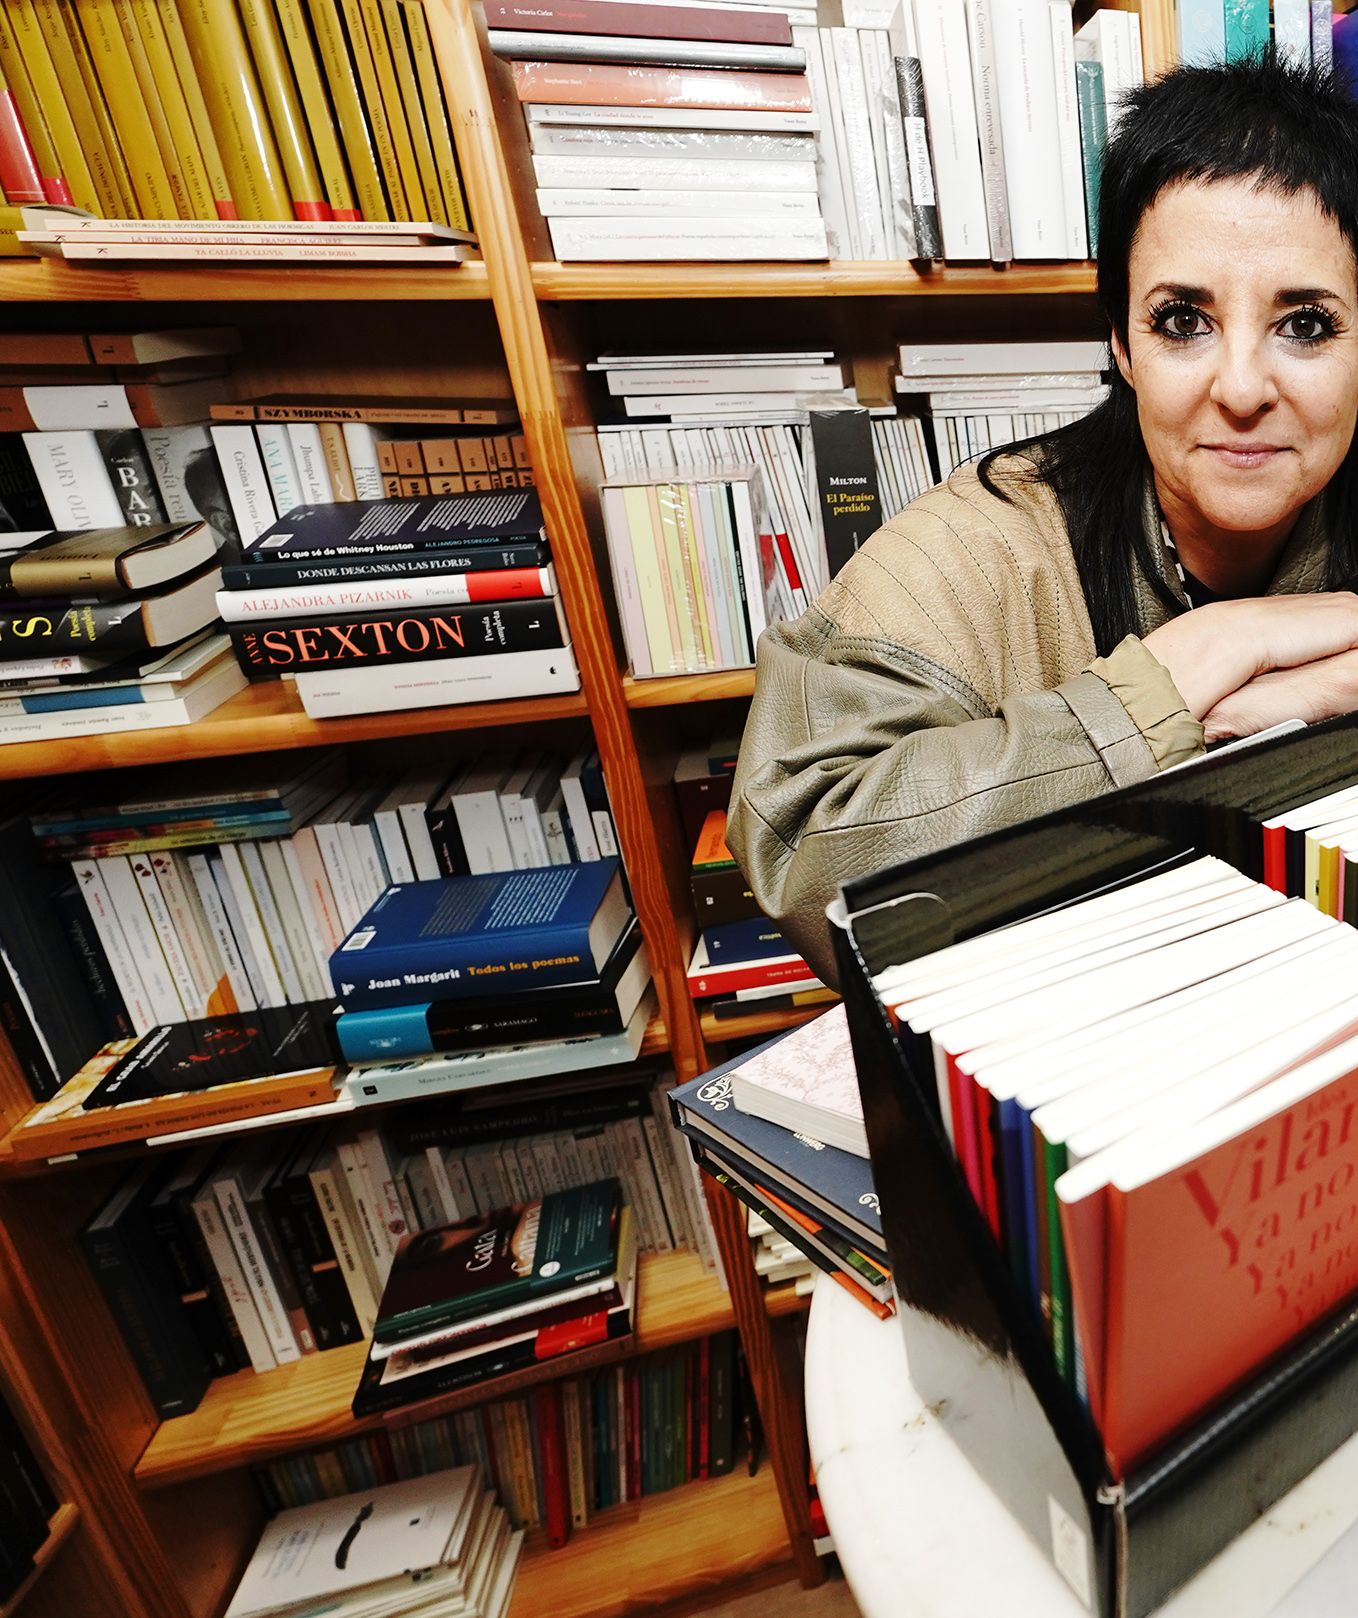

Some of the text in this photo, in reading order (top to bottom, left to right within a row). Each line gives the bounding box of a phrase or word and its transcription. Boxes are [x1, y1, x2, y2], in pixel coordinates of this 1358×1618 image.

[513, 8, 537, 17] Victoria
[976, 10, 986, 49] Carson
[981, 65, 997, 156] Norma enrevesada
[916, 156, 930, 200] Playbook
[264, 408, 362, 419] SZYMBORSKA
[150, 436, 178, 491] Poesía
[263, 439, 277, 470] ANA
[299, 445, 315, 481] Jhumpa
[47, 443, 92, 529] MARY OLIV
[233, 450, 258, 520] Cristina Rivera
[826, 492, 875, 503] El Paraíso
[833, 503, 871, 516] perdido
[278, 550, 290, 559] Lo
[292, 549, 310, 560] que
[311, 546, 322, 557] sé
[323, 547, 335, 556] de
[336, 544, 374, 557] Whitney
[375, 541, 415, 553] Houston
[297, 557, 472, 579] DONDE DESCANSAN LAS FLORES
[241, 585, 456, 612] ALEJANDRA PIZARNIK Poesía
[261, 614, 466, 666] SEXTON
[484, 615, 495, 643] Poesía
[493, 608, 507, 647] completa
[368, 954, 580, 991] Joan Margarit Todos los poemas
[493, 1016, 538, 1029] SARAMAGO
[1220, 1212, 1280, 1269] Ya
[1296, 1163, 1354, 1222] no
[1247, 1247, 1297, 1296] Ya
[1310, 1203, 1357, 1253] no
